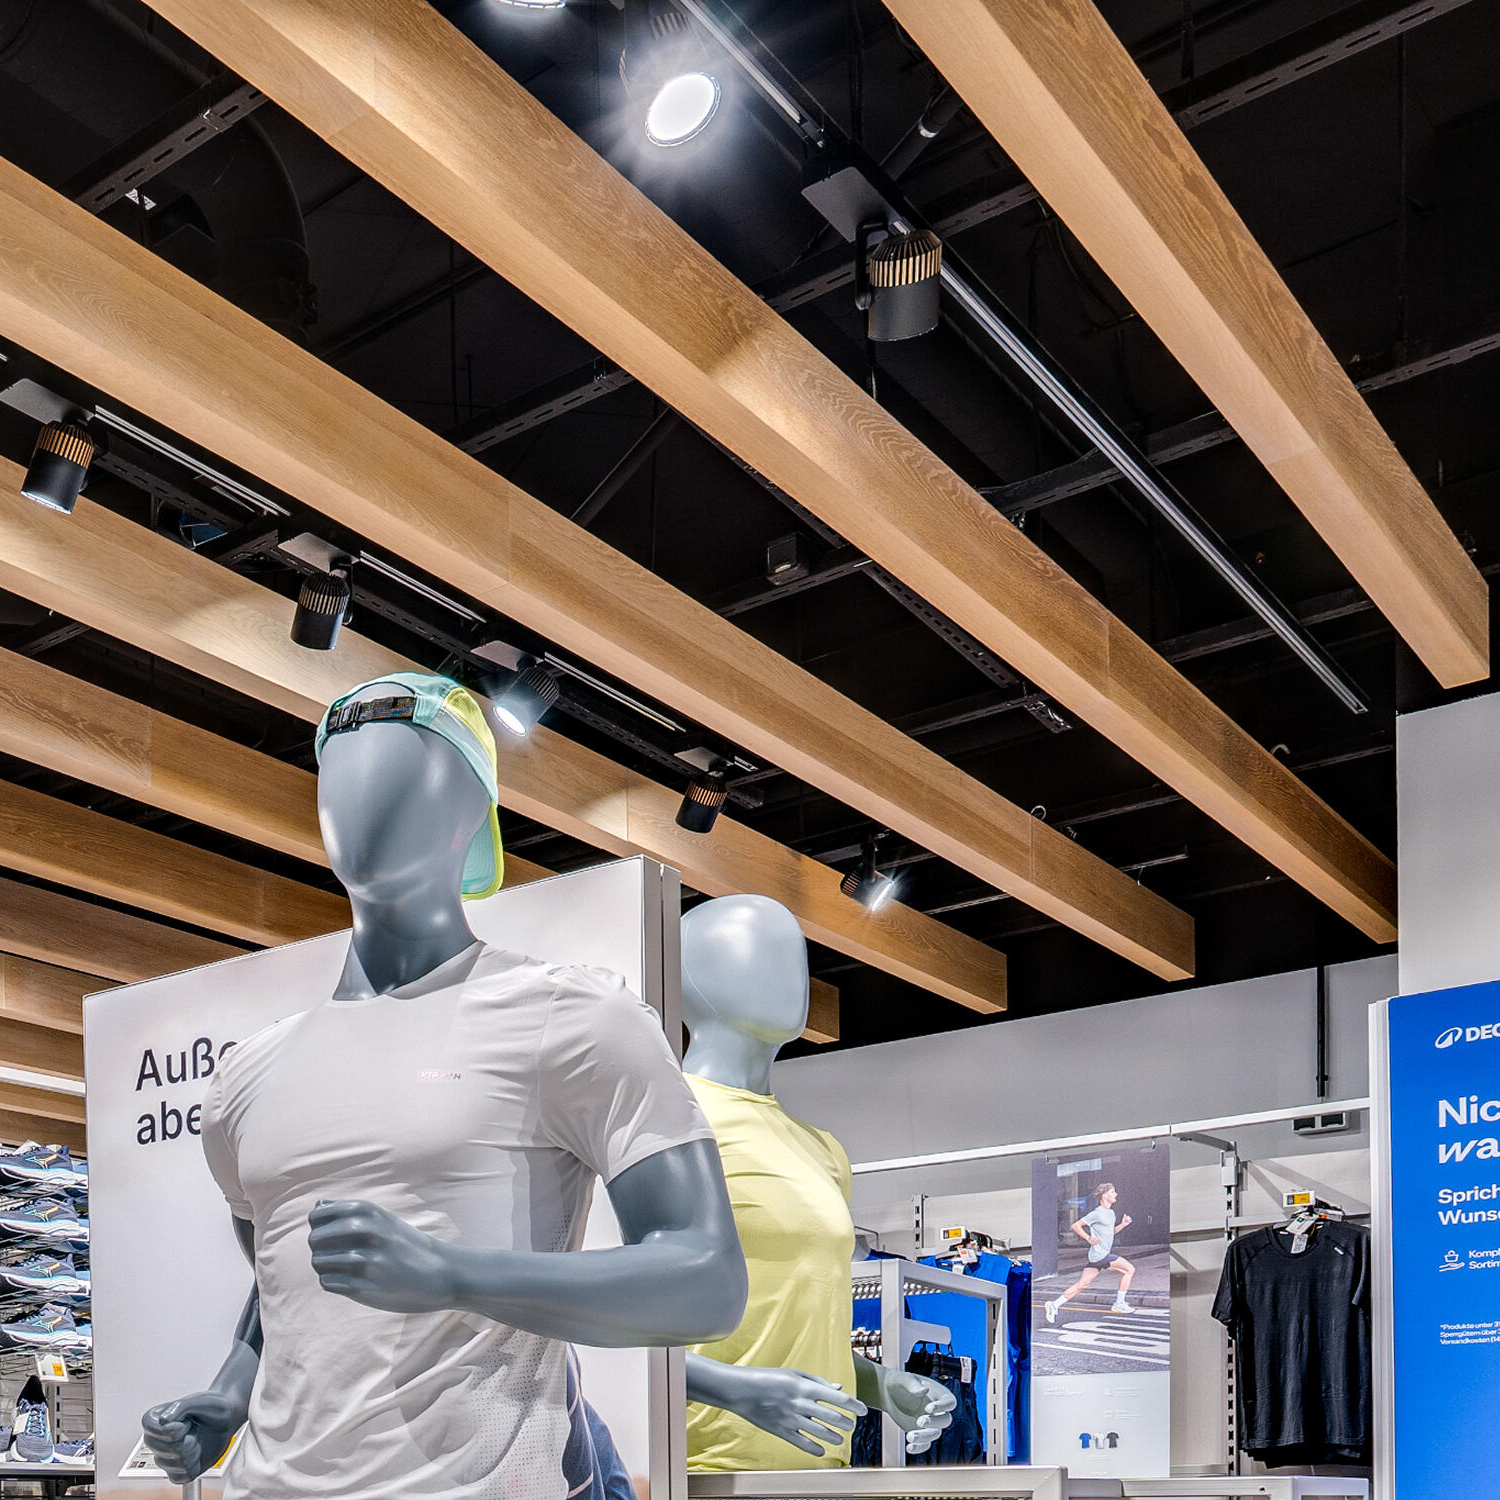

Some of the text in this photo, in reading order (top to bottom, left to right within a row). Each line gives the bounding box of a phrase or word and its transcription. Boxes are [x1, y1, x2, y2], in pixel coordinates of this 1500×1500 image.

[137, 1100, 202, 1145] abe
[1438, 1095, 1500, 1128] Nic
[1438, 1137, 1500, 1164] wa
